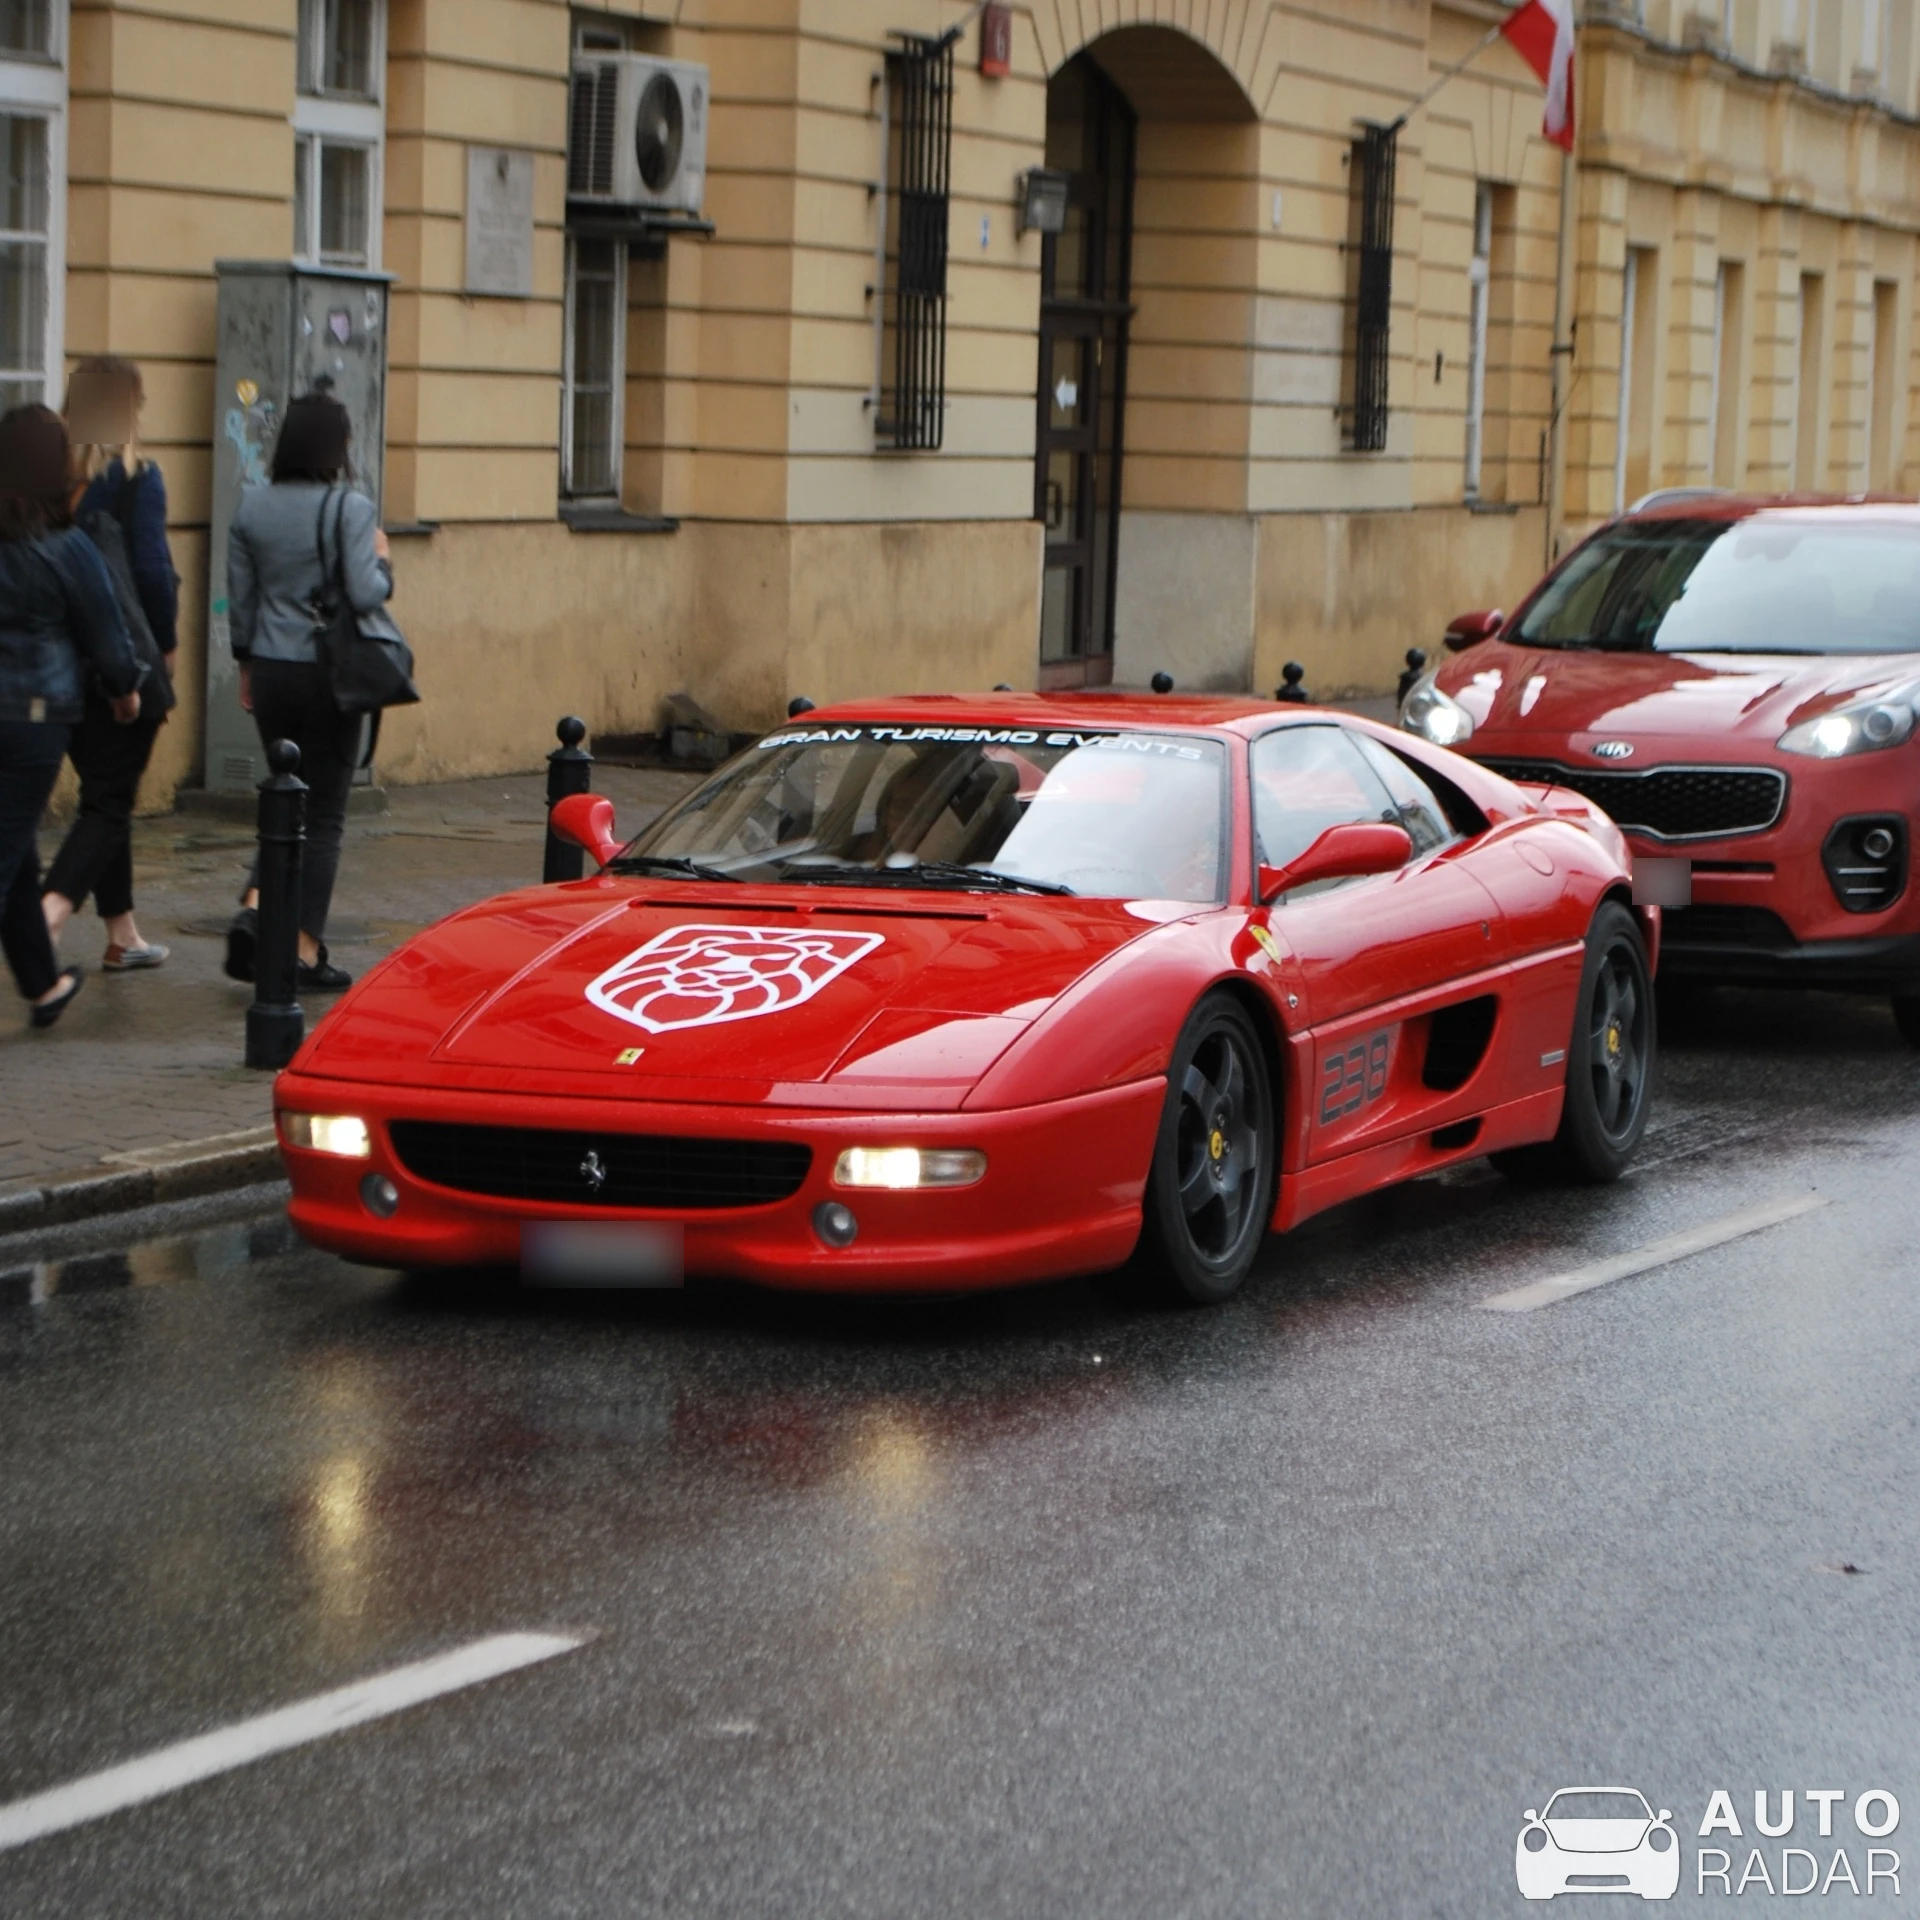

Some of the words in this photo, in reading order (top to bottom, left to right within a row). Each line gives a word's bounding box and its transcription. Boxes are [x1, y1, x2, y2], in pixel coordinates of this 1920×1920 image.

[758, 729, 862, 749] GRAN
[871, 728, 1039, 744] TURISMO
[1046, 732, 1203, 761] EVENTS
[1595, 741, 1628, 758] KIA
[1320, 1033, 1388, 1126] 238
